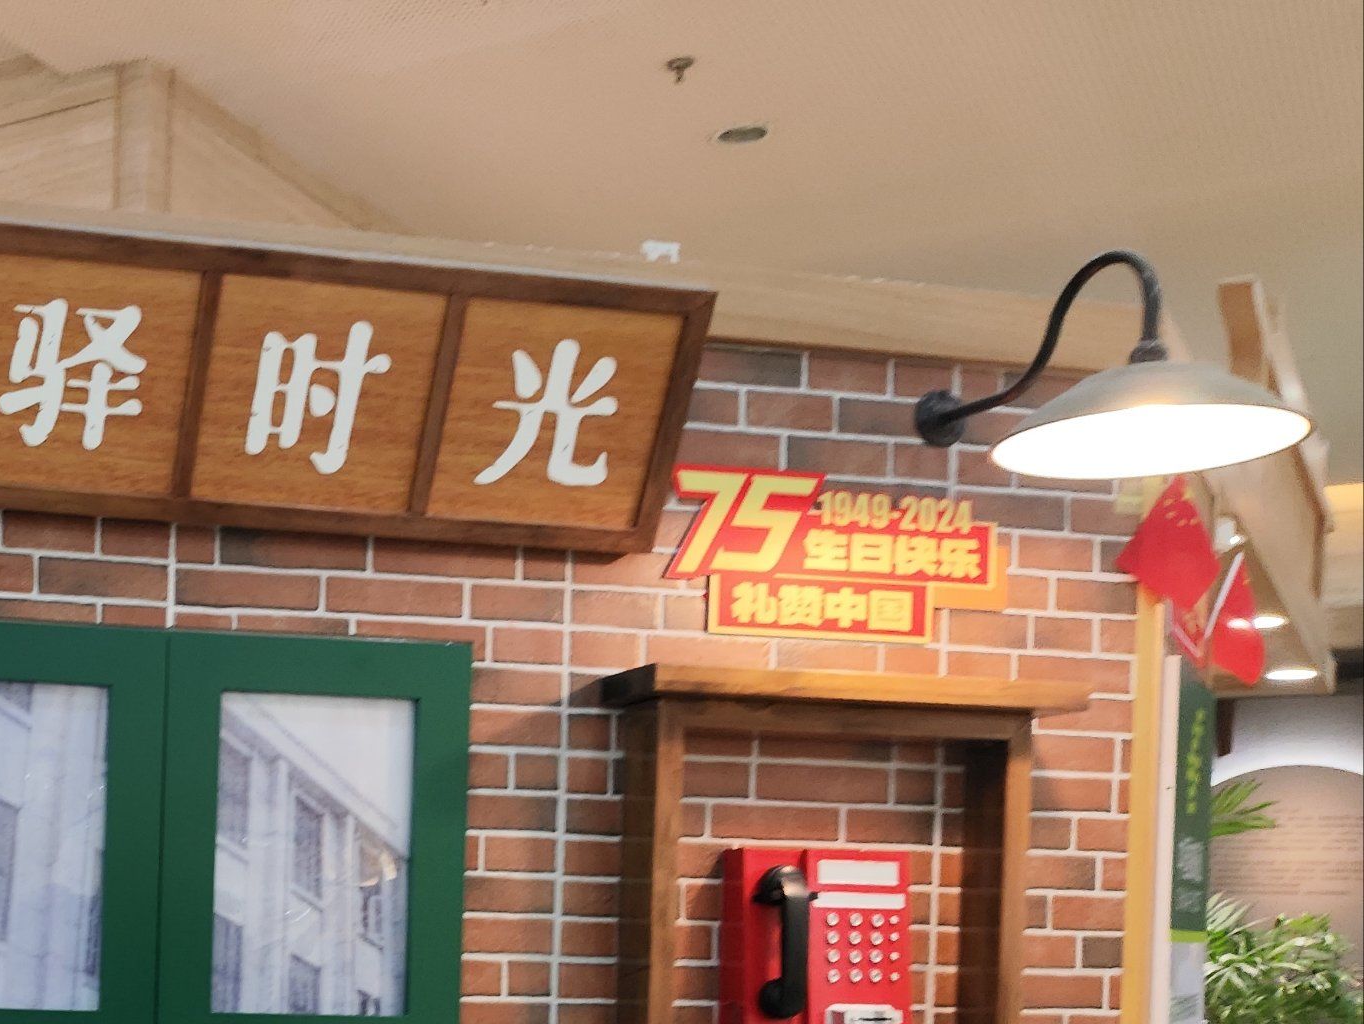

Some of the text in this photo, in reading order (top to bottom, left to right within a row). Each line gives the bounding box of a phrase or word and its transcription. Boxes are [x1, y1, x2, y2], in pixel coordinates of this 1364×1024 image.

[676, 470, 821, 574] 75
[816, 490, 974, 533] 1949-2024
[802, 528, 983, 580] 生日快乐
[730, 581, 915, 633] 礼赞中国
